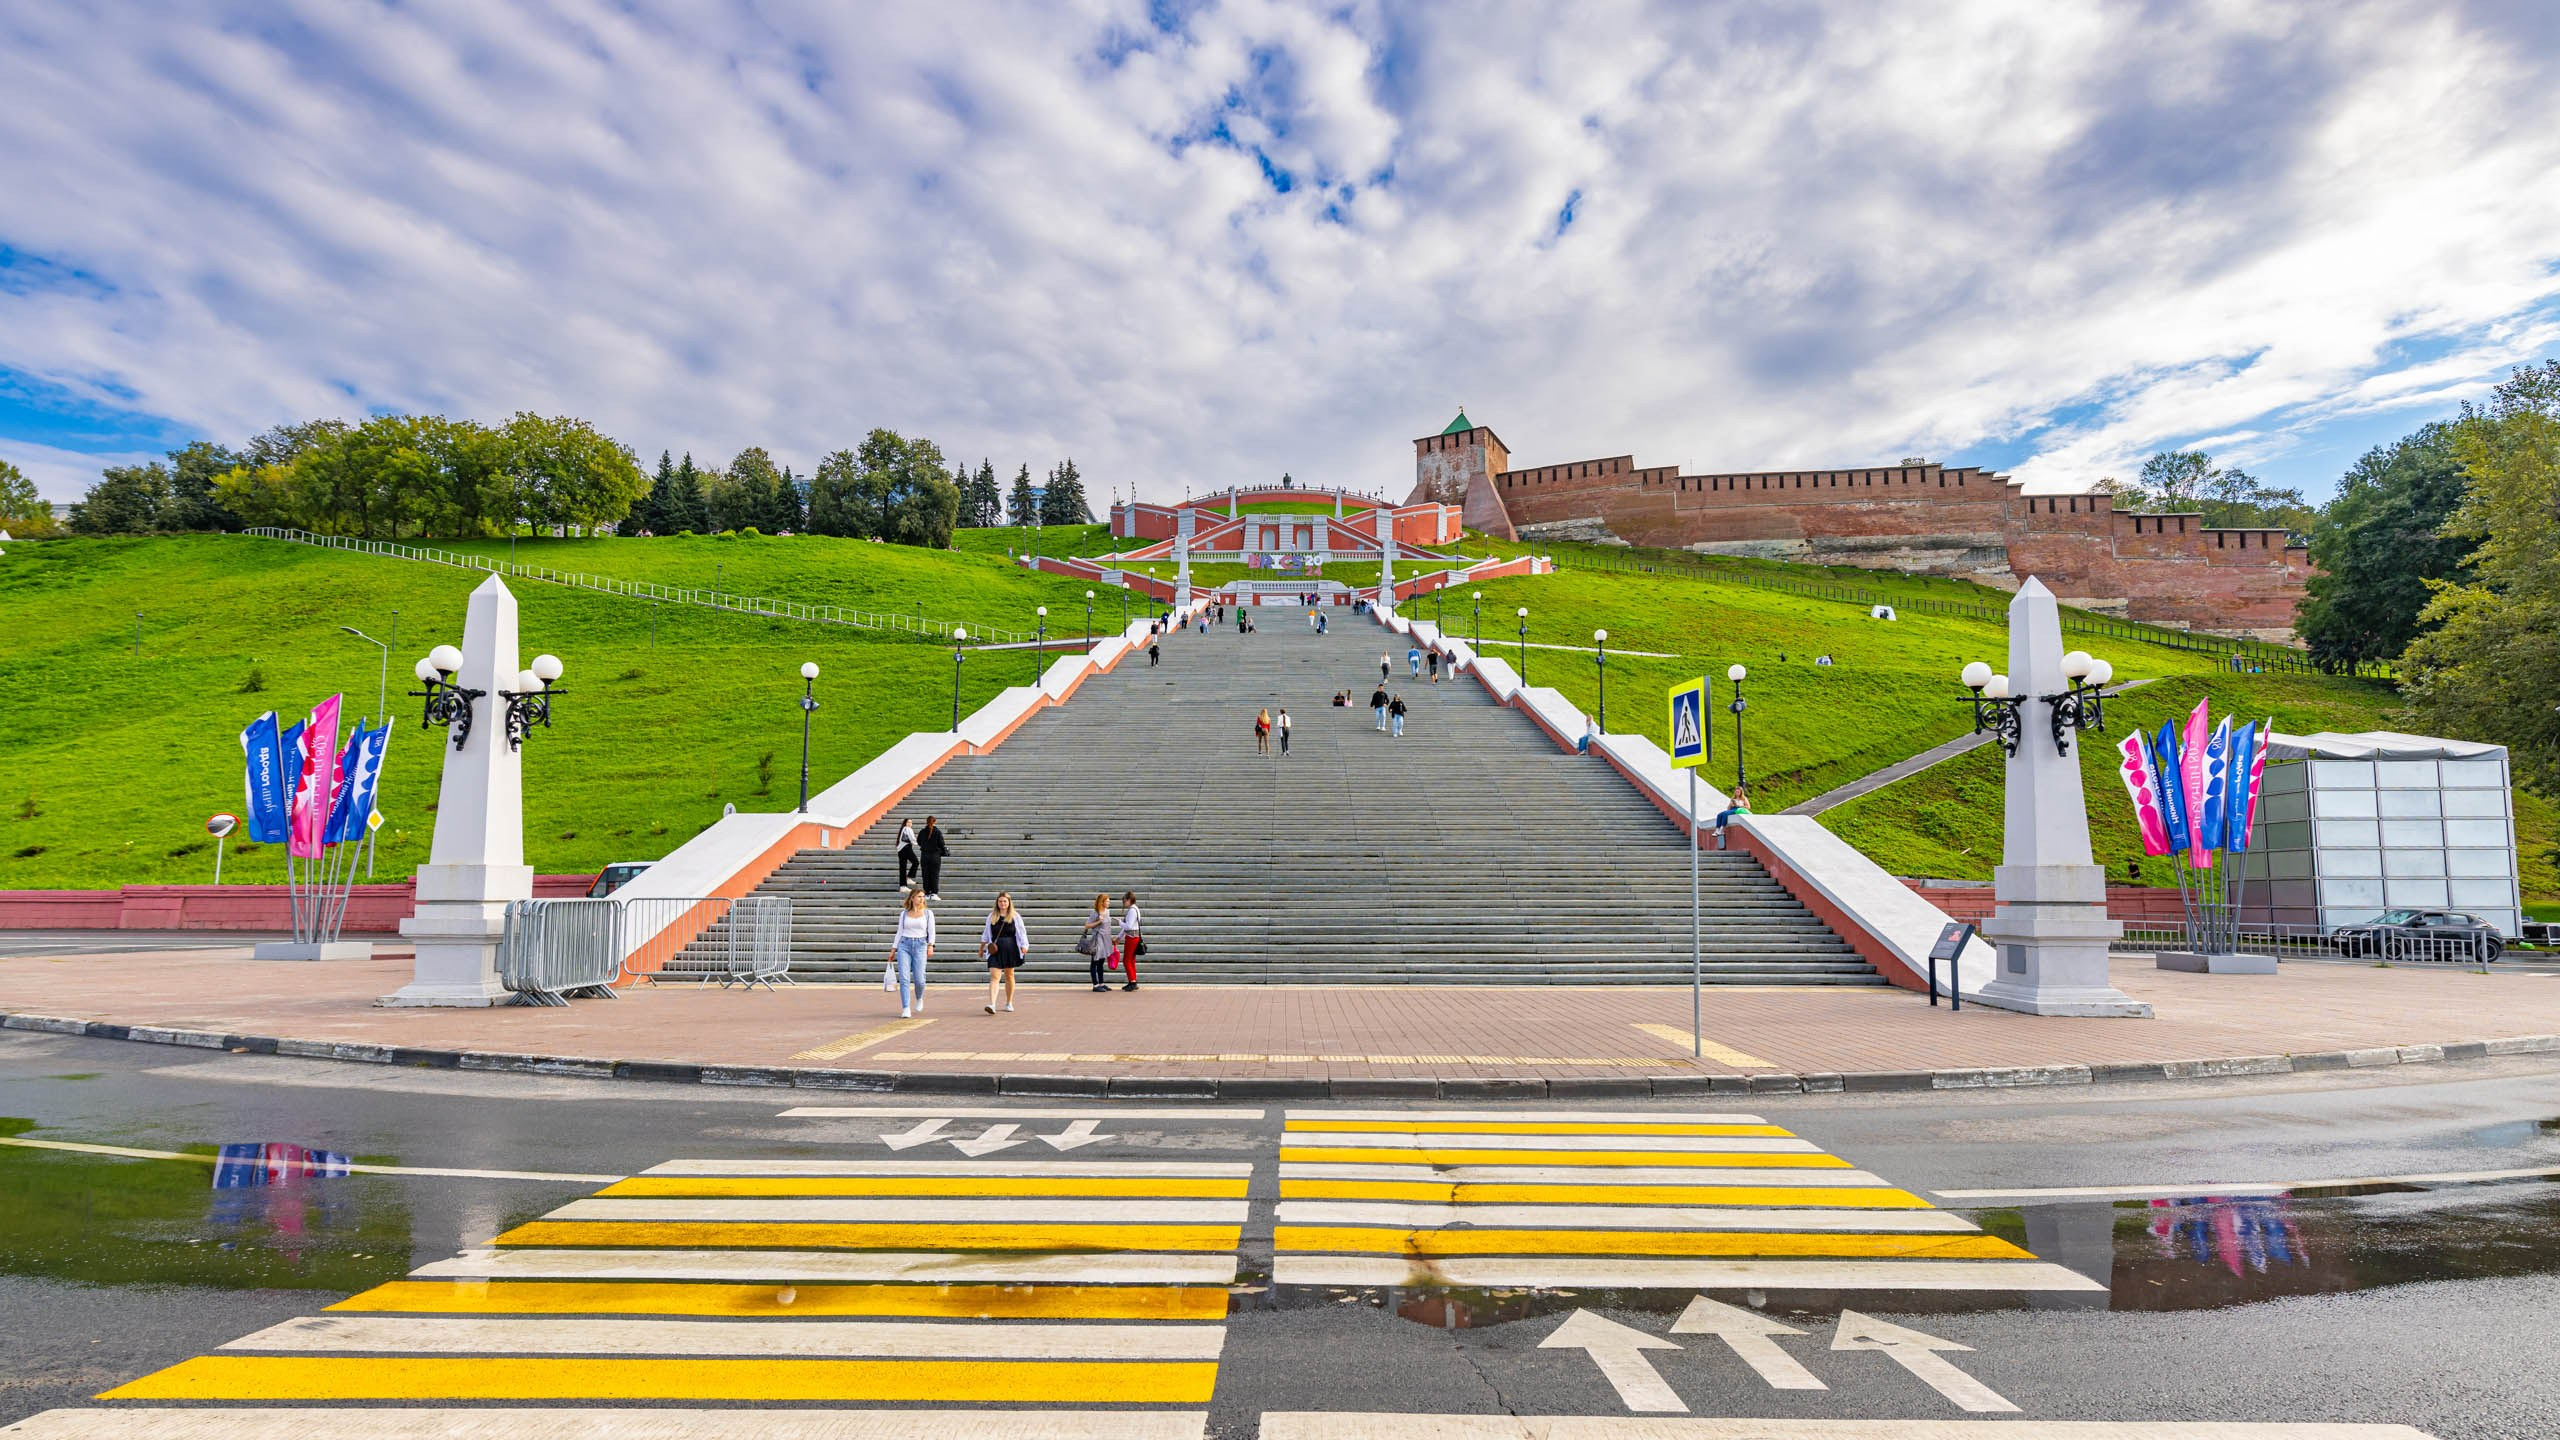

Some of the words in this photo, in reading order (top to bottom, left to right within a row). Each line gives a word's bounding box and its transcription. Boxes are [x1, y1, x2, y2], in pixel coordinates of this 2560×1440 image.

[1248, 555, 1302, 569] BRICS
[1305, 555, 1323, 566] 20
[1305, 566, 1322, 576] 24
